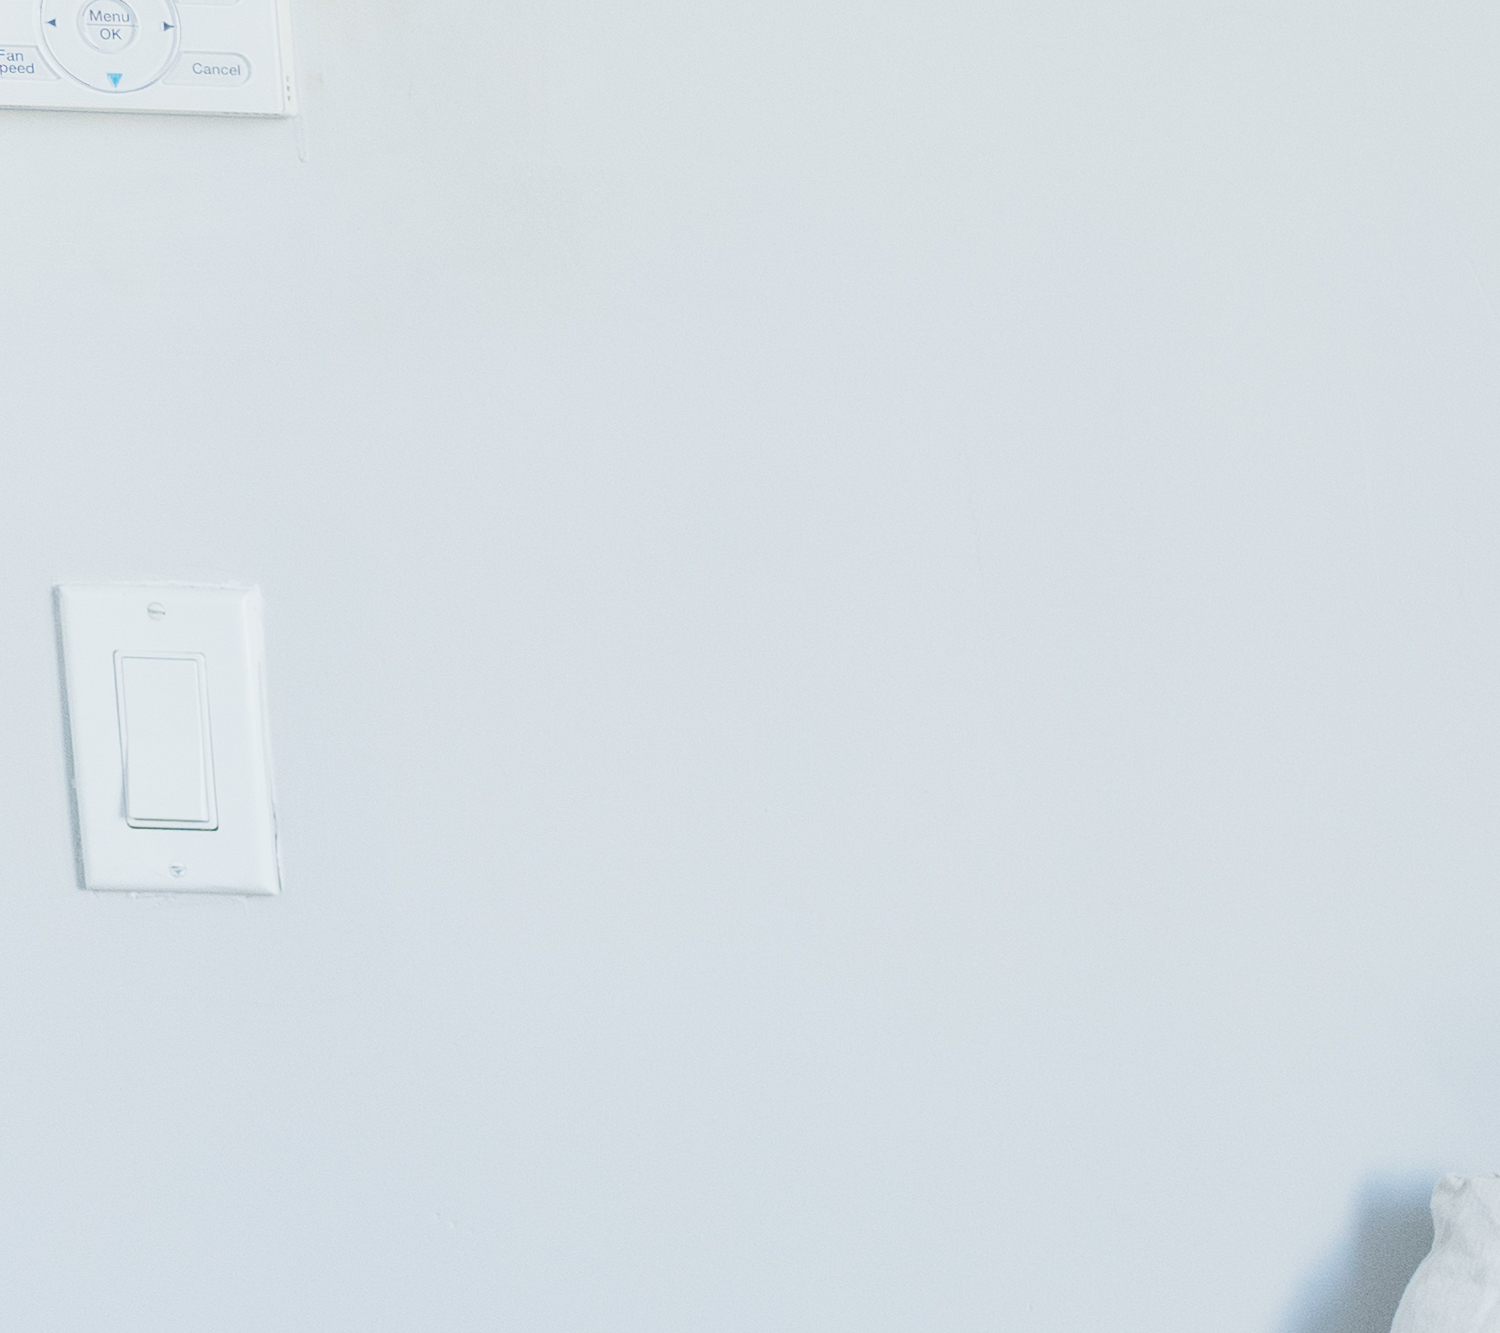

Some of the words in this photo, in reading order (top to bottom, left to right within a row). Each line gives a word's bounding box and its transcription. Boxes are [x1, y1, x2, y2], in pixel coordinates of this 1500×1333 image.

[89, 10, 130, 22] Menu
[100, 28, 122, 41] OK
[0, 63, 35, 76] peed
[192, 62, 241, 76] Cancel
